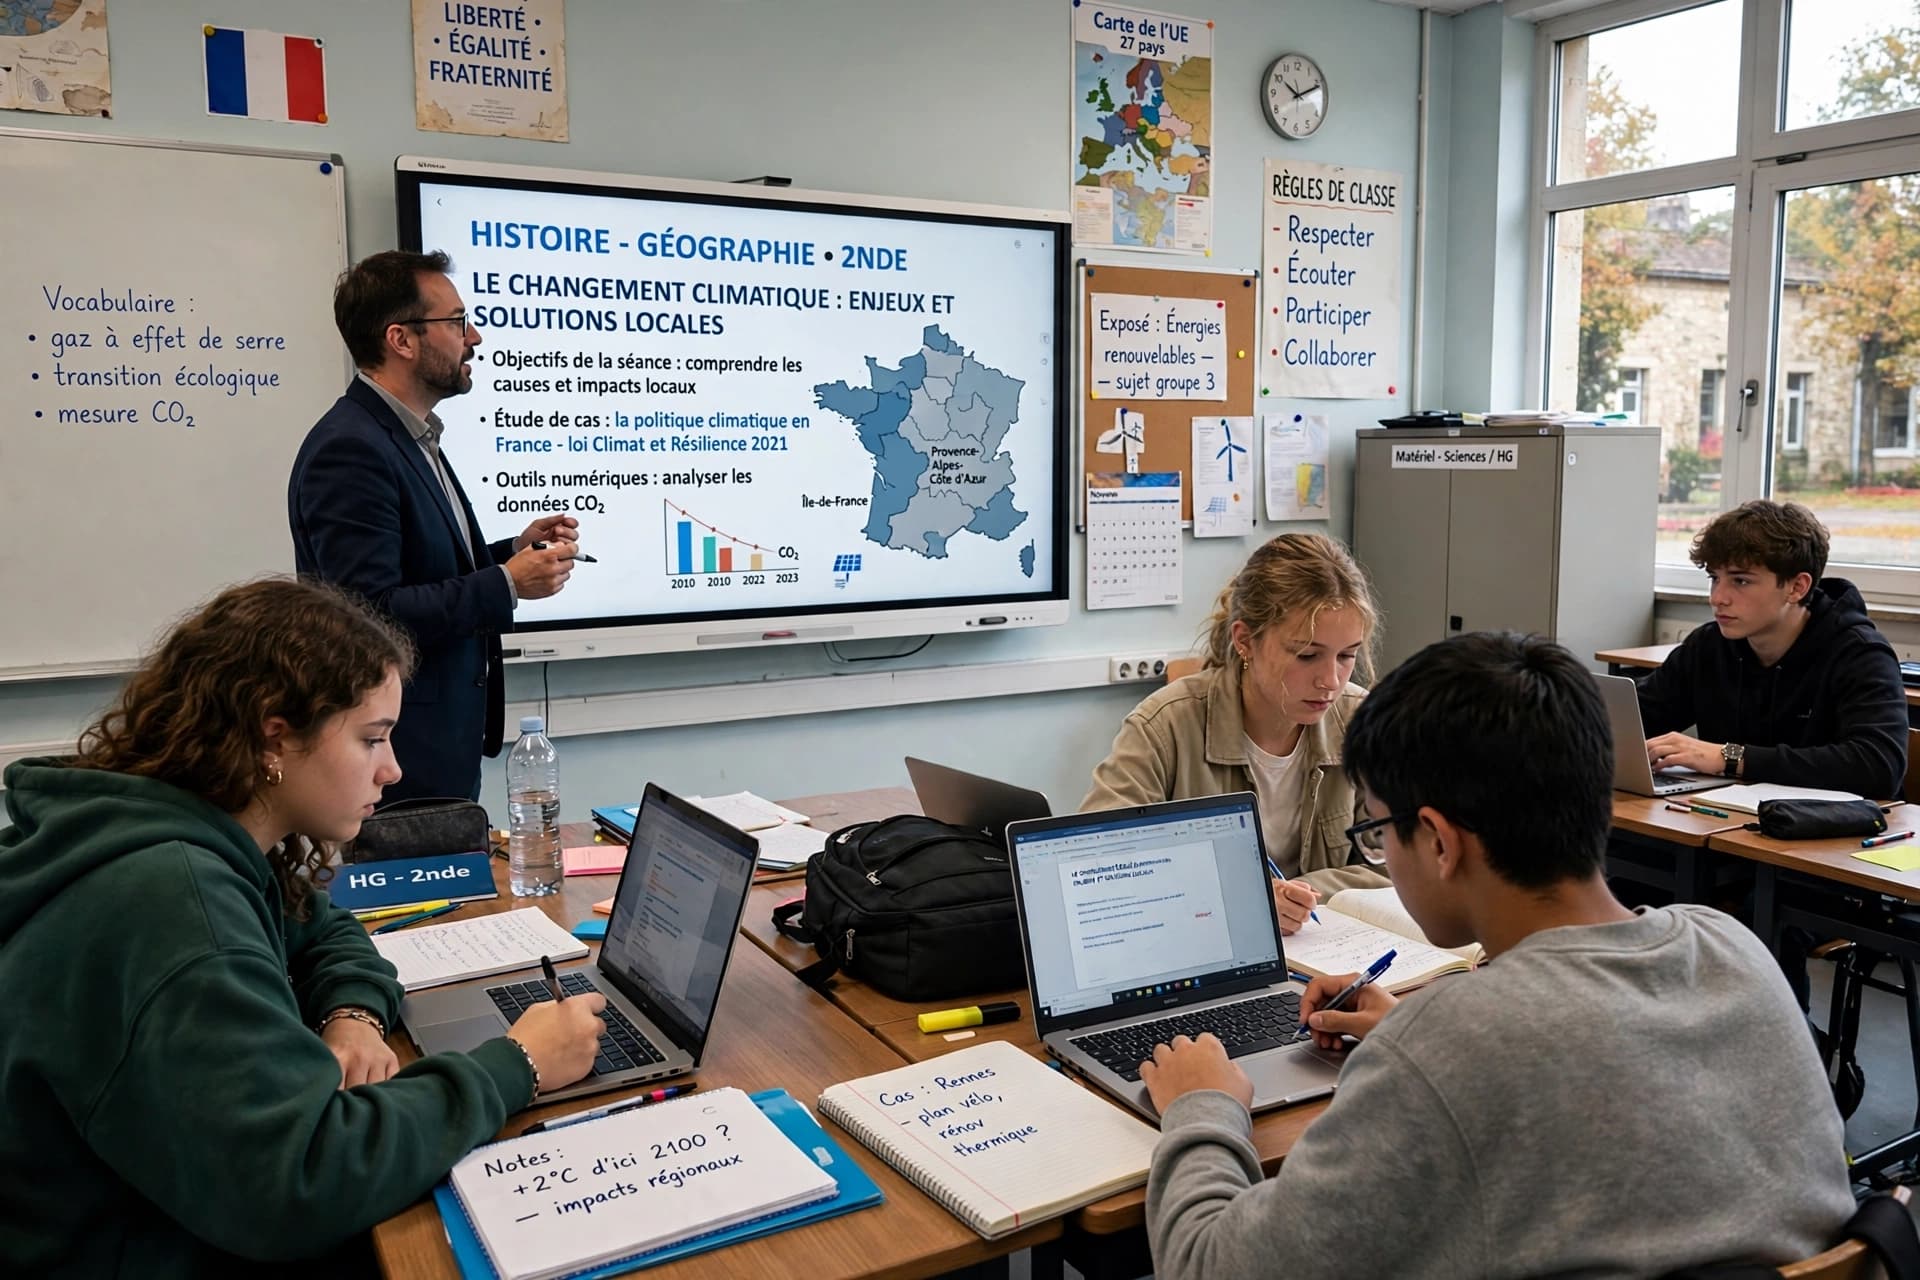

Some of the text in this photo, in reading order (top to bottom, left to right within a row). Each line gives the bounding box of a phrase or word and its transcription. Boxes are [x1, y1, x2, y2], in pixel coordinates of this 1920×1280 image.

[444, 2, 526, 31] LIBERTÉ
[1094, 12, 1188, 43] Carte de l'UE
[450, 28, 531, 60] ÉGALITÉ
[1121, 36, 1164, 56] 27 pays
[430, 60, 552, 92] FRATERNITÉ
[1273, 169, 1395, 207] RÈGLES DE CLASSE
[472, 221, 610, 253] HISTOIRE
[638, 227, 814, 265] GÉOGRAPHIE
[842, 245, 907, 271] 2NDE
[1289, 215, 1374, 254] Respecter
[1289, 249, 1356, 286] Écouter
[43, 285, 175, 312] Vocabulaire
[474, 272, 500, 294] LE
[509, 274, 685, 302] CHANGEMENT
[693, 283, 829, 311] CLIMATIQUE
[850, 291, 925, 312] ENJEUX
[933, 295, 954, 314] ET
[474, 306, 723, 335] SOLUTIONS LOCALES
[1101, 310, 1149, 338] Exposé
[1167, 308, 1220, 342] Énergies
[1287, 297, 1371, 334] Participer
[52, 325, 285, 358] gaz à effet de serre
[1105, 344, 1195, 364] renouvelables
[1285, 339, 1376, 366] Collaborer
[493, 350, 568, 371] Objectifs
[573, 352, 593, 368] de
[599, 352, 612, 368] la
[618, 353, 671, 369] séance
[686, 356, 778, 374] comprendre
[783, 357, 802, 372] les
[54, 363, 279, 396] transition écologique
[494, 377, 696, 396] causes et impacts locaux
[1117, 372, 1150, 396] sujet
[1156, 378, 1200, 397] groupe
[1207, 373, 1214, 390] 3
[59, 409, 138, 423] mesure
[495, 408, 543, 427] Étude
[549, 411, 569, 427] de
[575, 416, 600, 427] cas
[616, 411, 628, 427] la
[635, 412, 704, 431] politique
[708, 412, 787, 432] climatique
[792, 417, 809, 428] en
[496, 437, 551, 452] France
[569, 436, 587, 452] loi
[593, 436, 645, 452] Climat
[650, 438, 666, 451] et
[672, 435, 747, 451] Résilience
[752, 436, 787, 450] 2021
[932, 446, 979, 457] Provence-
[1396, 450, 1435, 462] Matériel
[1444, 450, 1486, 462] Sciences
[1498, 450, 1512, 462] HG
[497, 471, 546, 487] Outils
[552, 470, 648, 489] numériques
[663, 468, 727, 487] analyser
[732, 468, 752, 483] les
[930, 473, 986, 484] Côte d'Azur
[932, 460, 963, 474] Alpes-
[498, 495, 569, 512] données
[802, 494, 868, 507] Île-de-France
[672, 573, 798, 589] 2010 2010 2022 2023
[350, 873, 386, 888] HG
[411, 866, 469, 882] 2nde
[880, 1092, 914, 1106] Cas
[934, 1069, 995, 1089] Rennes
[919, 1108, 955, 1127] plan
[939, 1120, 983, 1139] rénov
[593, 1153, 636, 1175] d'ici
[651, 1135, 706, 1159] 2100
[716, 1125, 730, 1141] ?
[953, 1124, 1037, 1156] thermique
[485, 1153, 550, 1177] Notes
[554, 1179, 637, 1214] impacts
[648, 1153, 742, 1187] régionaux
